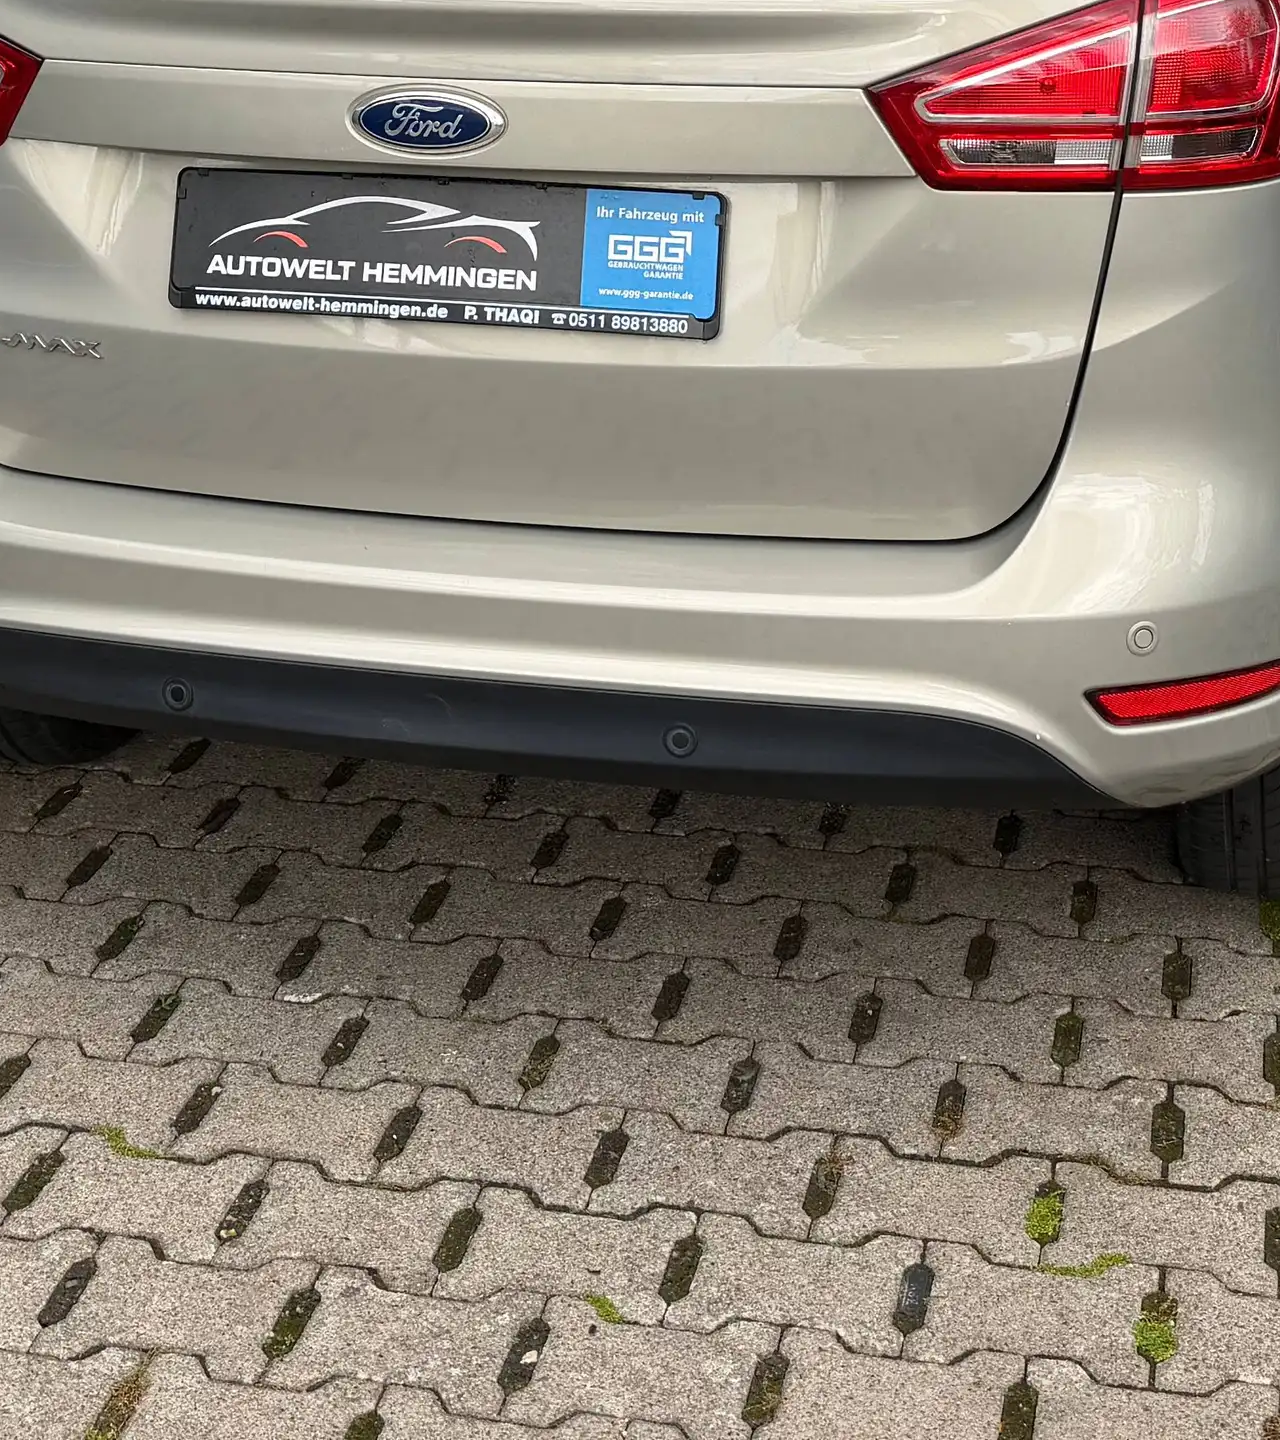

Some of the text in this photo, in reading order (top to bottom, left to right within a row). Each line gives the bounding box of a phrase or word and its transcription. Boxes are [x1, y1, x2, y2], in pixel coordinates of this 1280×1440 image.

[384, 103, 463, 138] Ford
[596, 206, 704, 224] Ihr Fahrzeug mit
[608, 233, 687, 264] GGG
[206, 255, 537, 291] AUTOWELT HEMMINGEN
[608, 260, 683, 272] GEBRAUCHTWAGEN
[643, 271, 683, 280] GARANTIE
[598, 288, 694, 300] www.ggg-garantie.de
[195, 293, 688, 334] www.autowelt-hemmingen.de P. THAQI 0511 89813880
